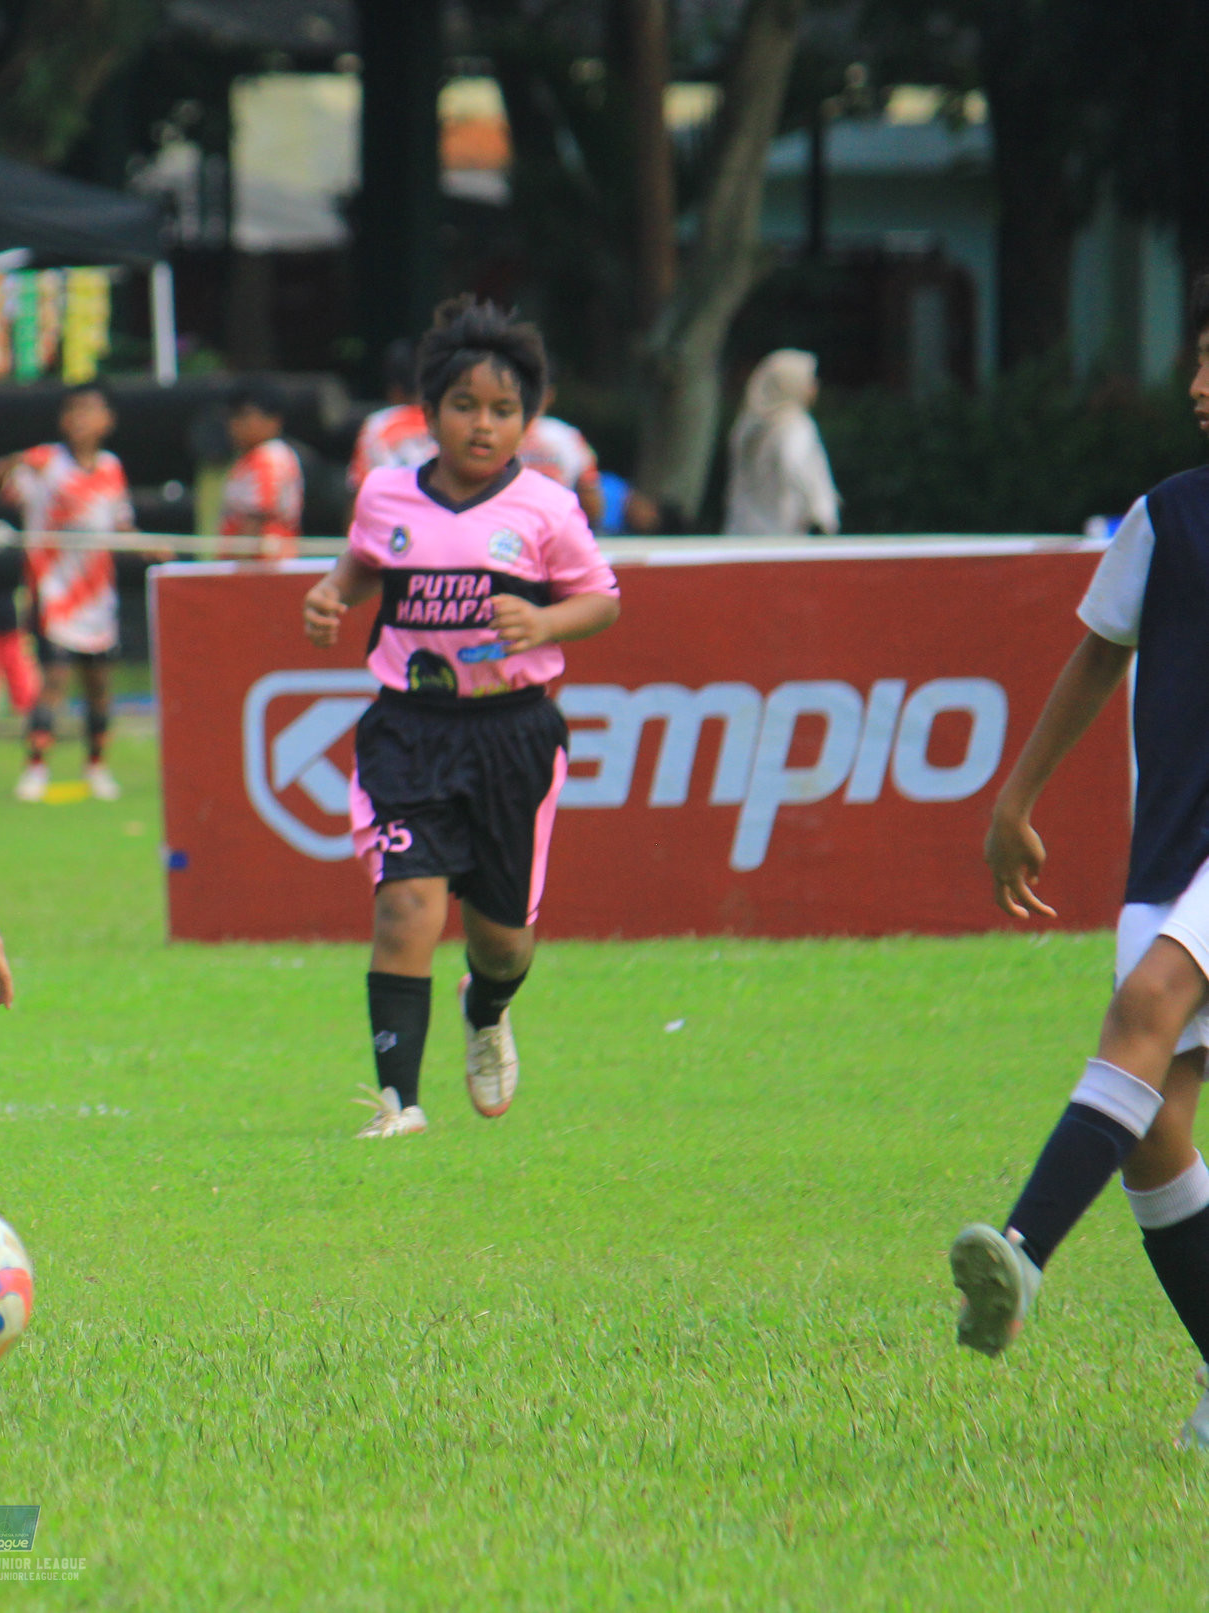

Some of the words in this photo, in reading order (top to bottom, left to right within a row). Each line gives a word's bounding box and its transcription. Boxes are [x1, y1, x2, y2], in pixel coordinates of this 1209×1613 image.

[407, 573, 492, 600] PUTRA
[396, 598, 494, 625] HARAPA
[554, 676, 1008, 873] ampio
